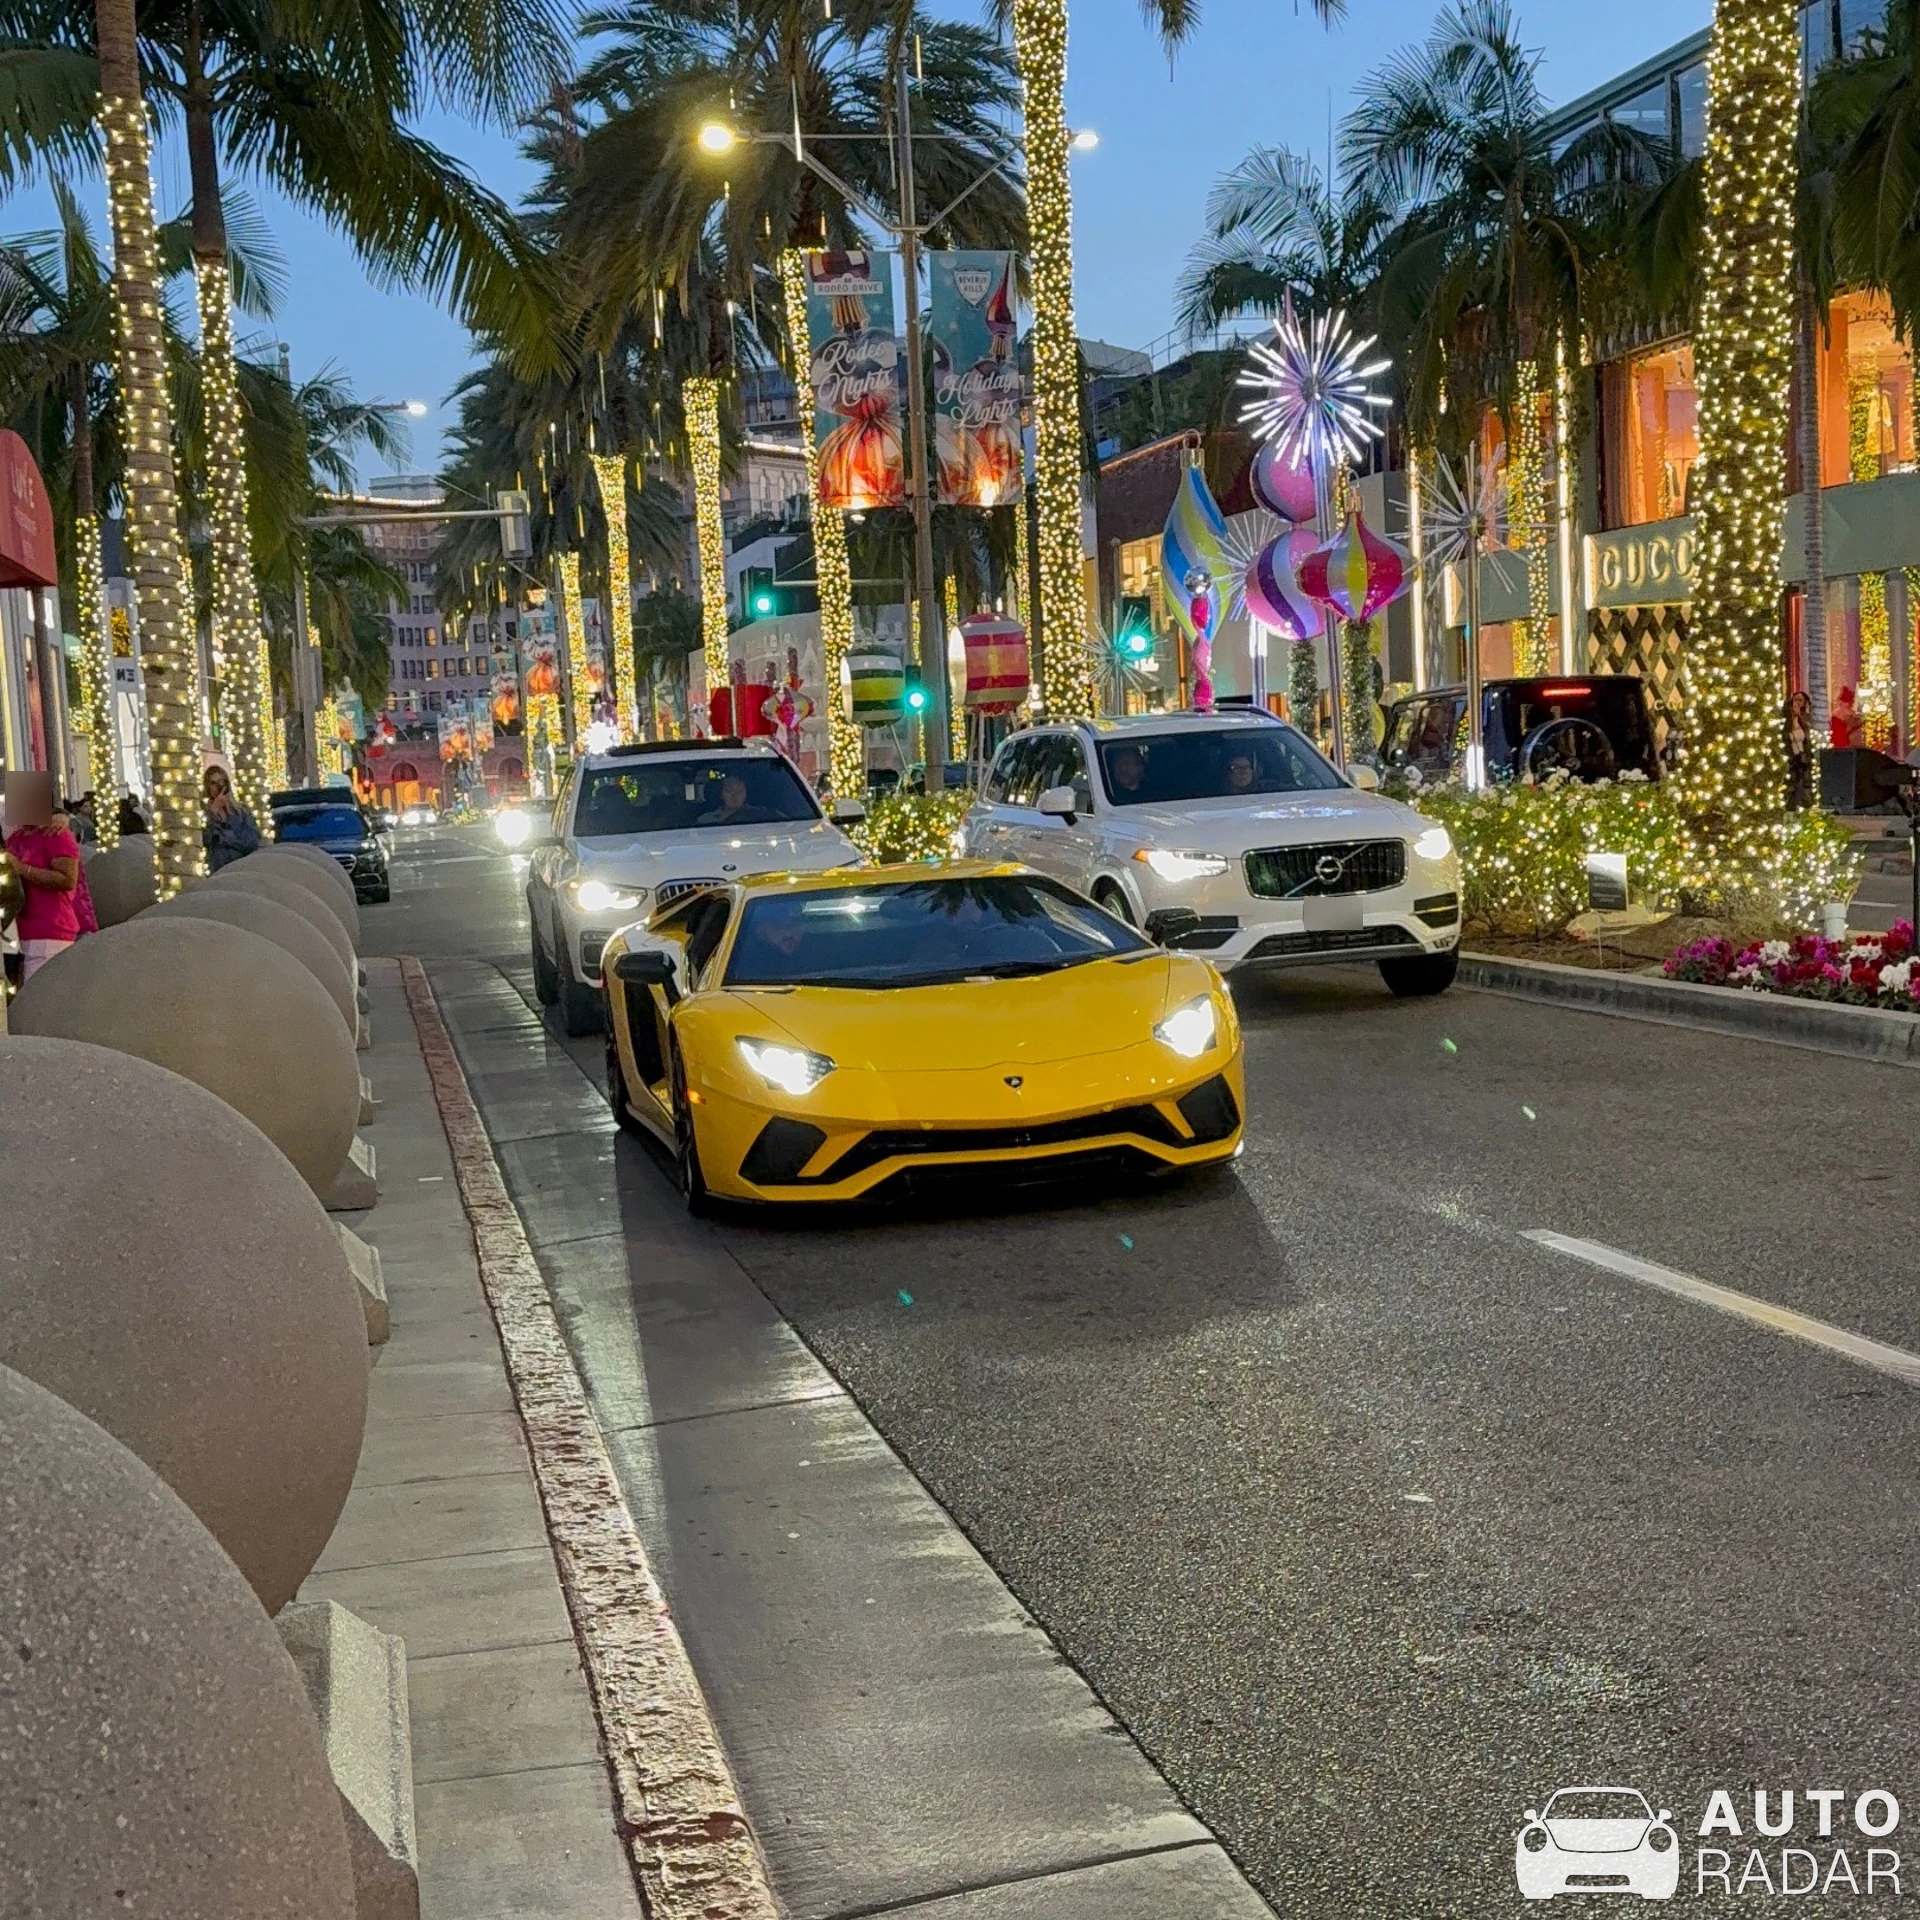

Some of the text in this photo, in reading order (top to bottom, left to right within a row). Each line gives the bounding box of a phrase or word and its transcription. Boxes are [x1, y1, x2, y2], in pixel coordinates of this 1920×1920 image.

[818, 282, 878, 293] RODEO DRIVE
[963, 284, 983, 292] HILLS
[821, 340, 886, 374] Rodeo
[817, 367, 893, 407] Nights
[936, 371, 1014, 405] Holiday
[950, 398, 1018, 428] Lights
[1601, 533, 1695, 590] GUCC
